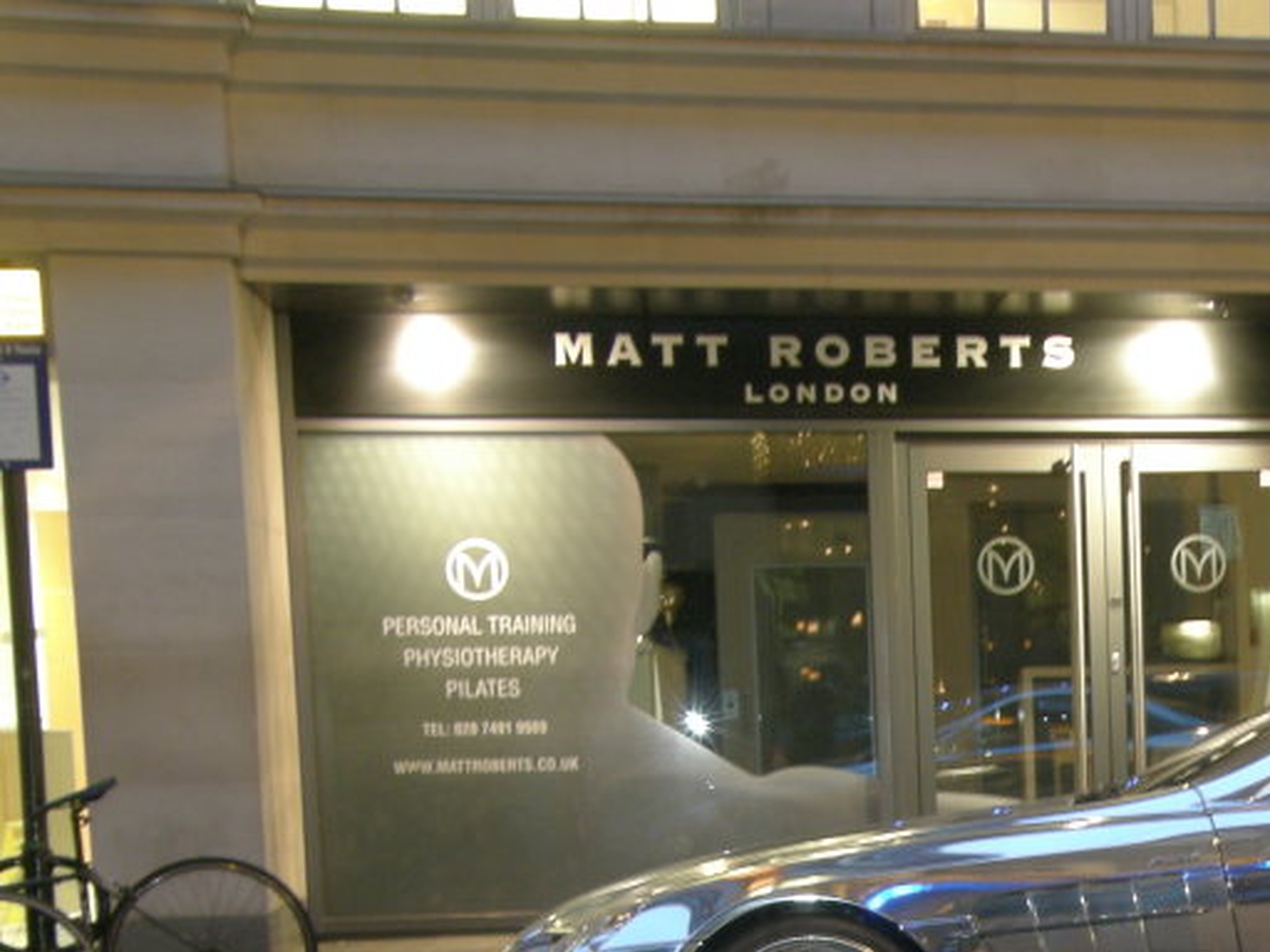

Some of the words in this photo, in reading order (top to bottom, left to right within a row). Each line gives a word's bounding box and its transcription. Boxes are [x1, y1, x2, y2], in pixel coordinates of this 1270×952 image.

[553, 331, 729, 368] MATT
[769, 334, 1076, 370] ROBERTS
[745, 383, 898, 405] LONDON
[382, 614, 482, 636] PERSONAL
[487, 613, 576, 635] TRAINING
[404, 645, 559, 668] PHYSIOTHERAPY
[446, 678, 520, 698] PILATES
